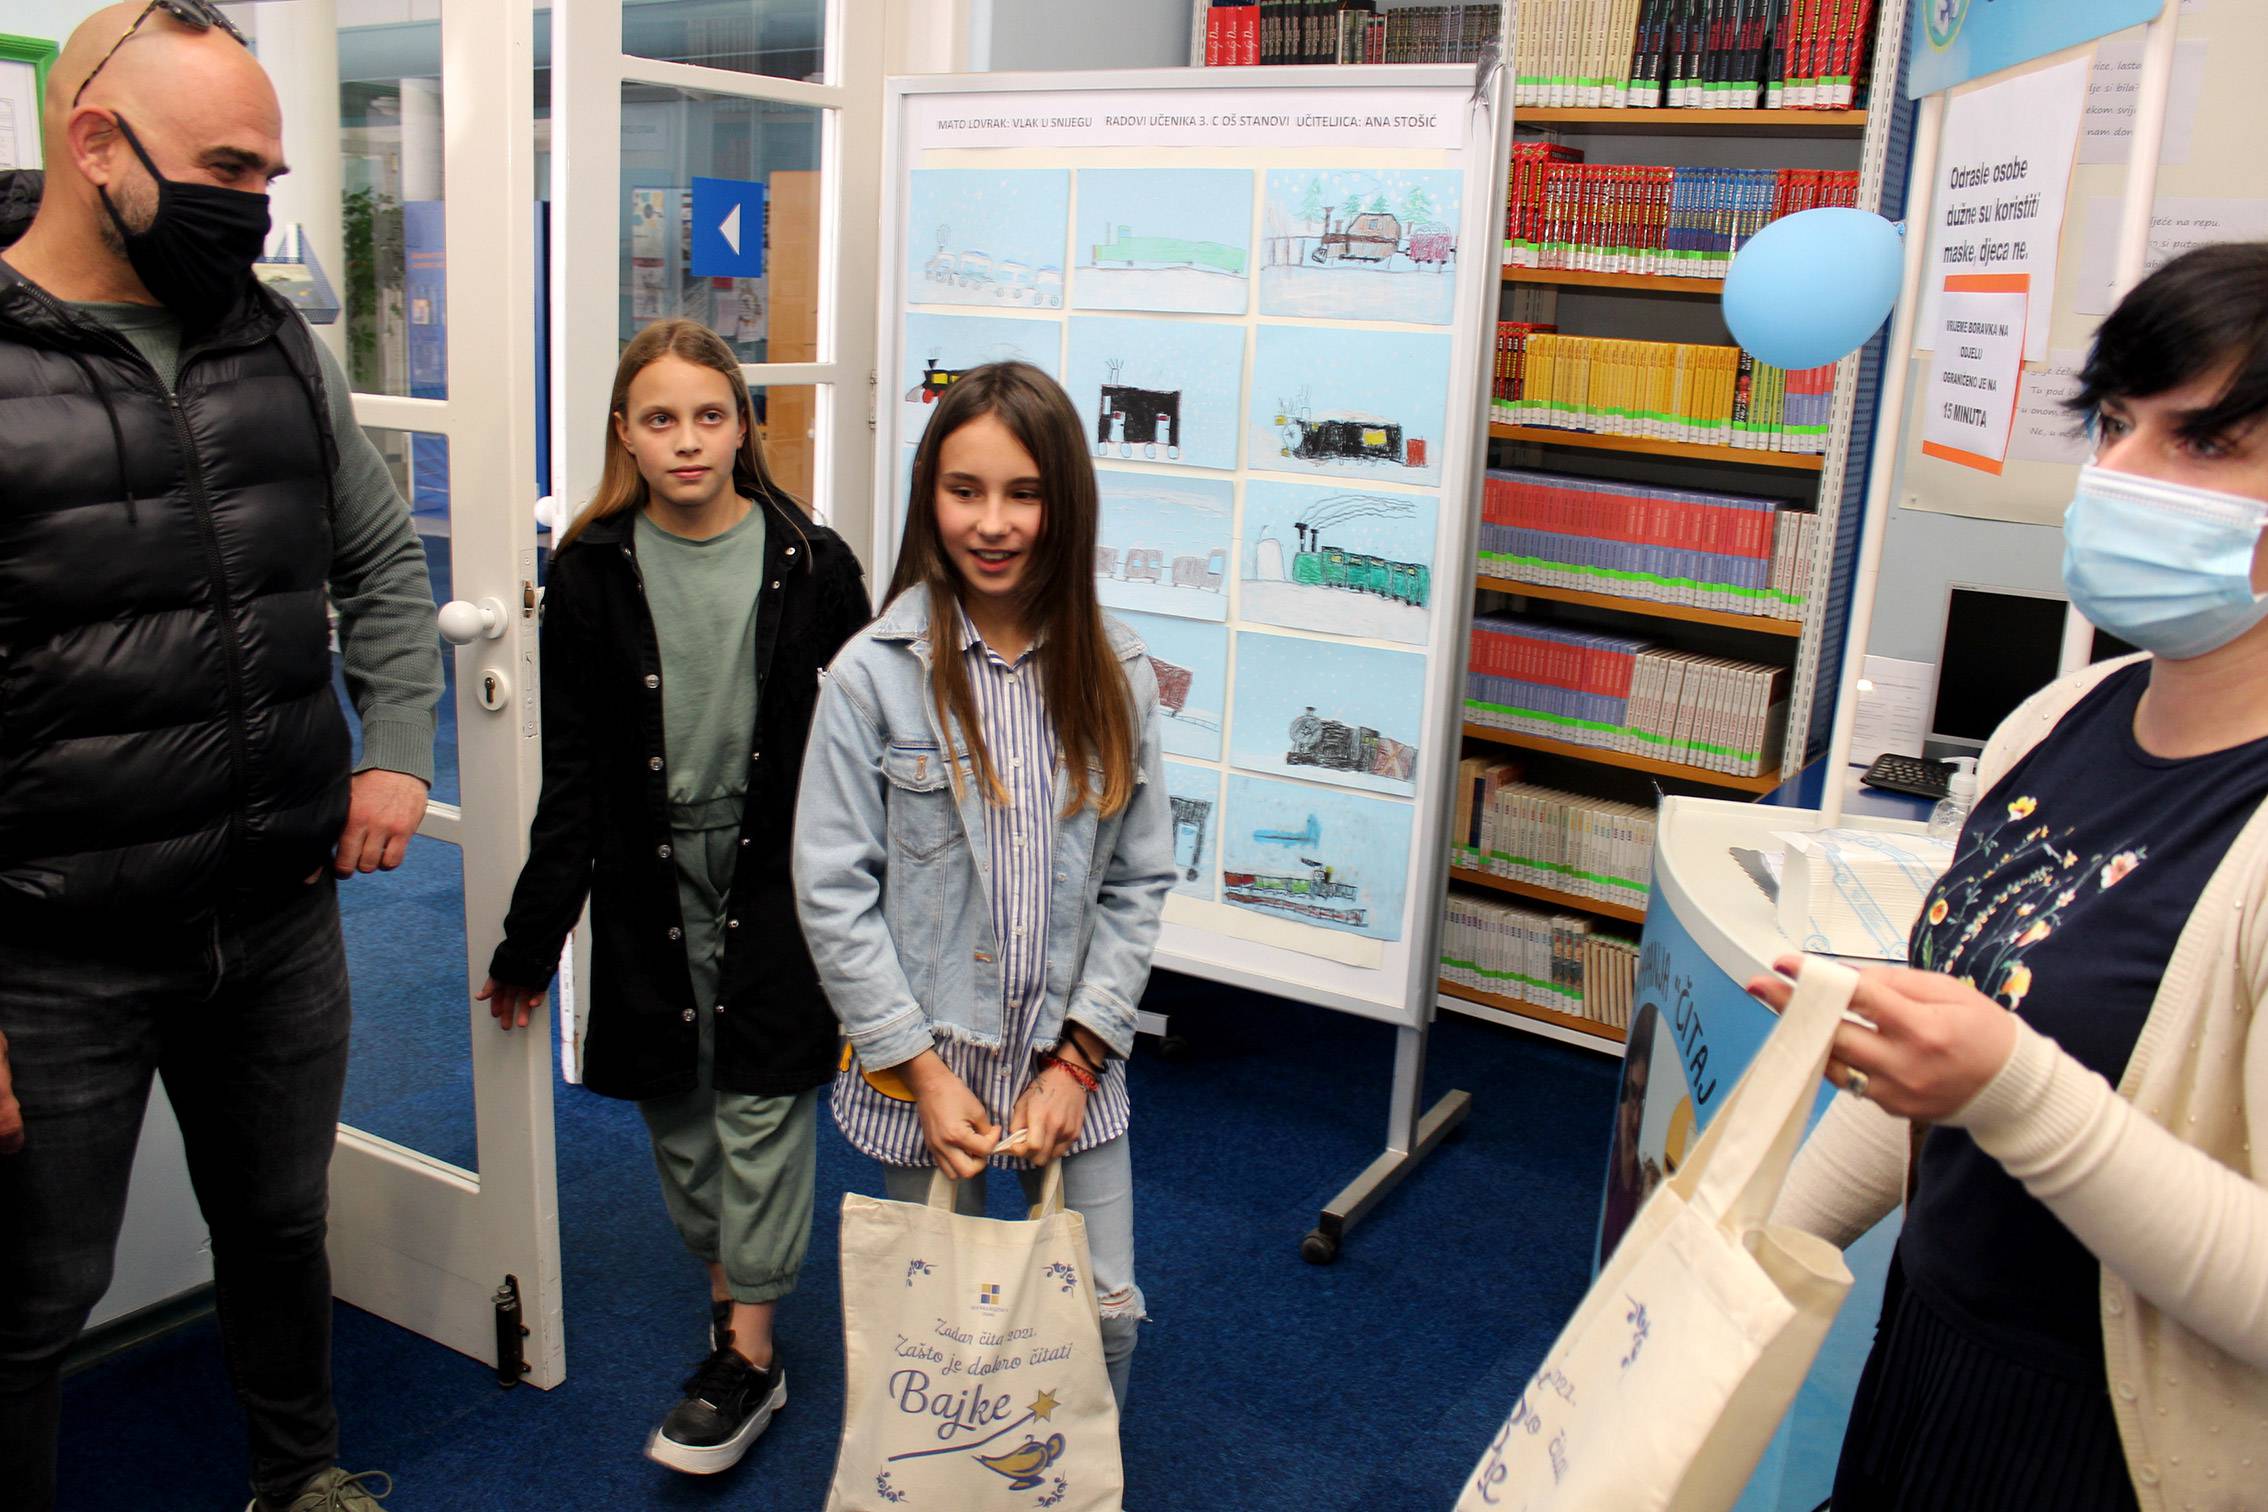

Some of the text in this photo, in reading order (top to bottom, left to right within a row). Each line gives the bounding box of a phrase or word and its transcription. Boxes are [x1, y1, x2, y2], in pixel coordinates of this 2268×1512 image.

[937, 112, 1438, 130] MATO LOVRAK: VLAK U SNIJEGU RADOVI UČENIKA 3. C OŠ STANOVI UČITELJICA: ANA STOŠIĆ
[1950, 154, 2029, 190] Odrasle osobe
[1946, 192, 2041, 227] dužne su koristiti
[1943, 237, 2029, 267] maske, djeca ne.
[1946, 320, 2009, 337] VRIJEME BORAVKA NA
[1960, 346, 1983, 360] ODJELU
[1943, 370, 1997, 392] OGRANIČENO JE NA
[1944, 401, 1987, 428] 15 MINUTA
[934, 1318, 1037, 1347] Zadar čita 2021.
[894, 1334, 1074, 1376] Zašto je dobro čitati
[888, 1369, 1012, 1440] Bajke
